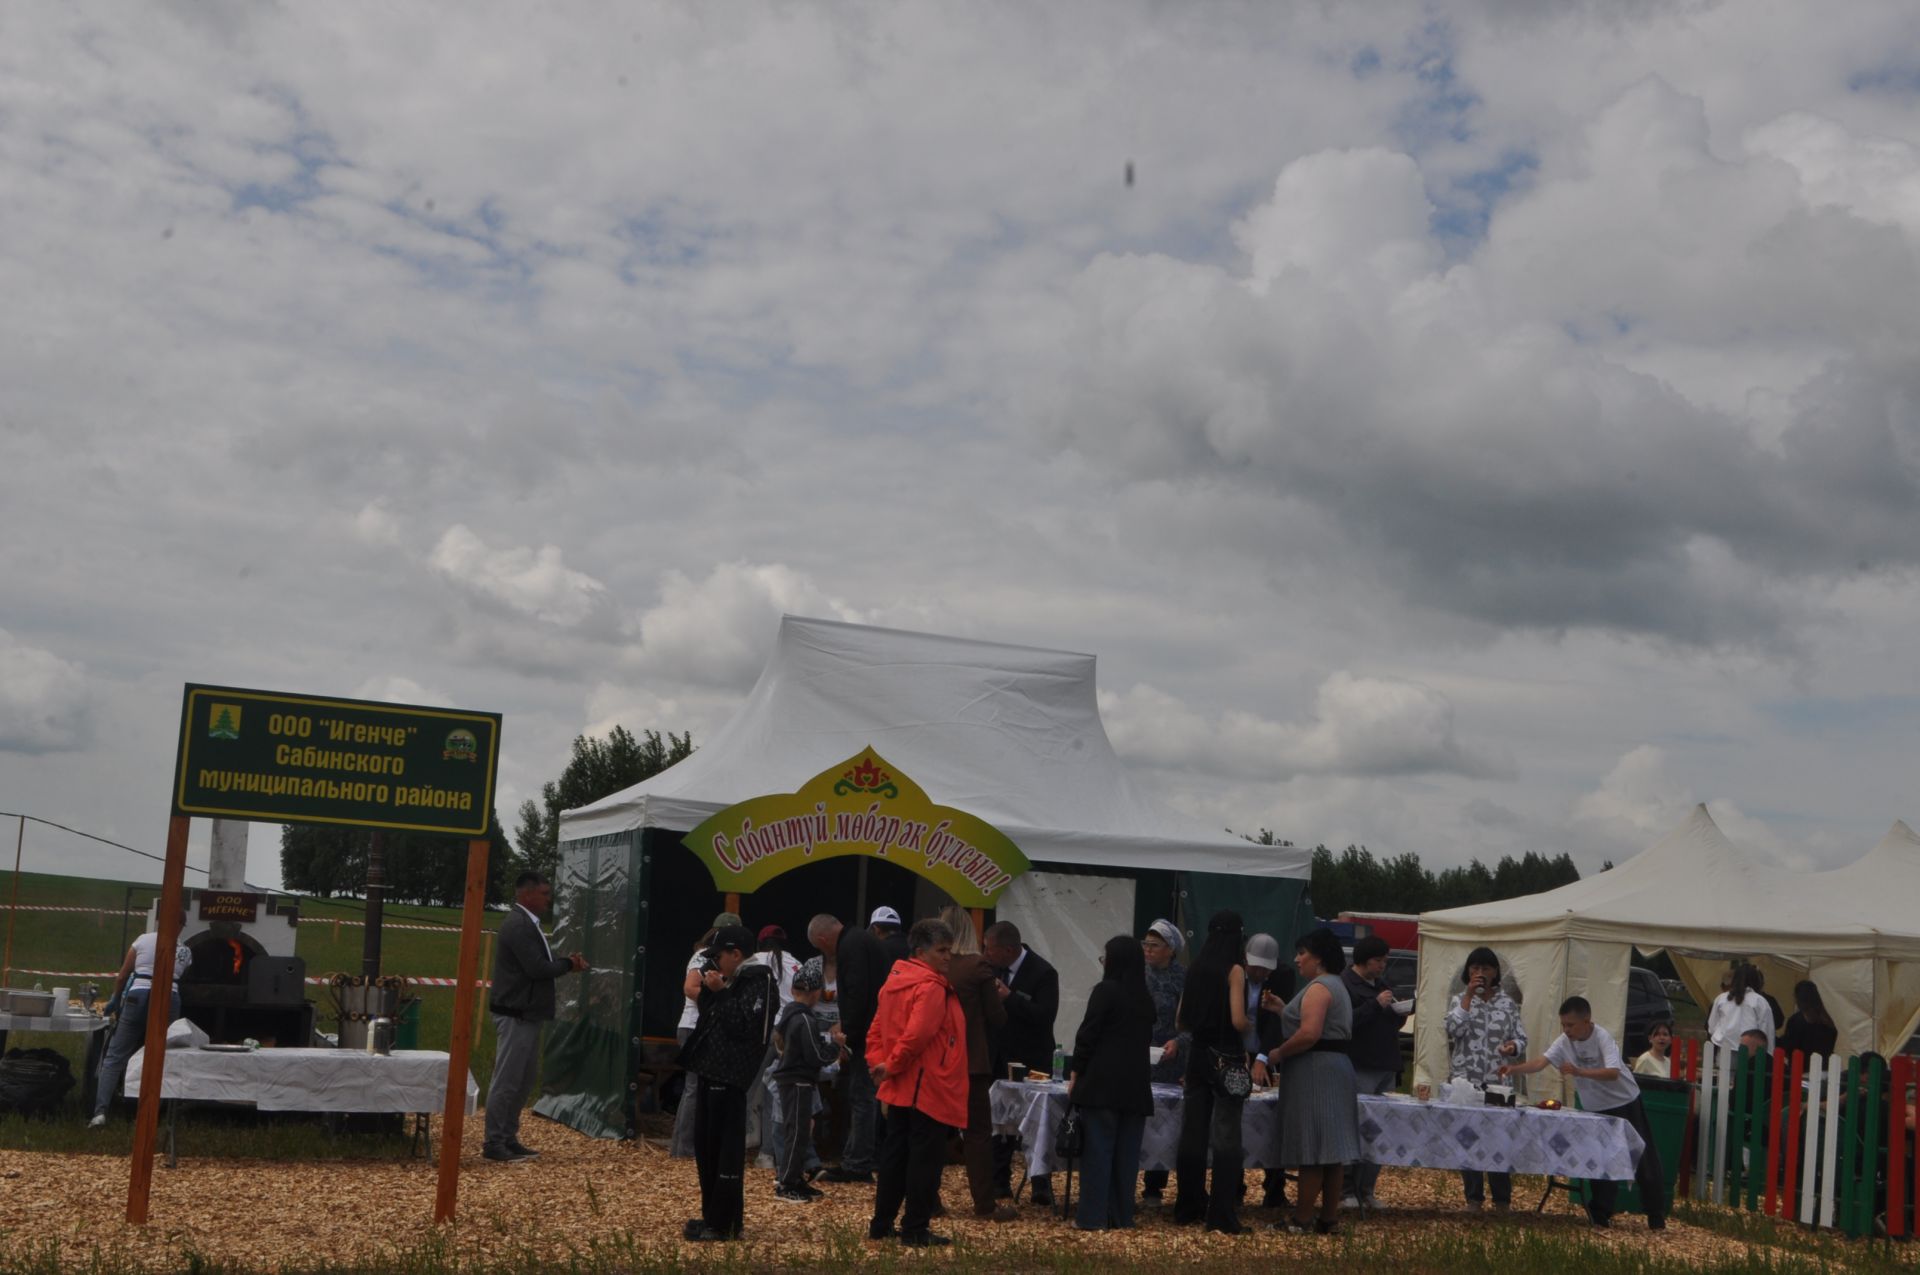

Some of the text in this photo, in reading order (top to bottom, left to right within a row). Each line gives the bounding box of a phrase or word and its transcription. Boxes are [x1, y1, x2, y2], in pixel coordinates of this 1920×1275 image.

[268, 713, 312, 738] ООО
[275, 743, 405, 775] Сабинского
[199, 768, 472, 810] муниципального района
[713, 801, 829, 873] Сабантуй
[924, 819, 1012, 896] булсын!
[216, 896, 241, 904] ООО
